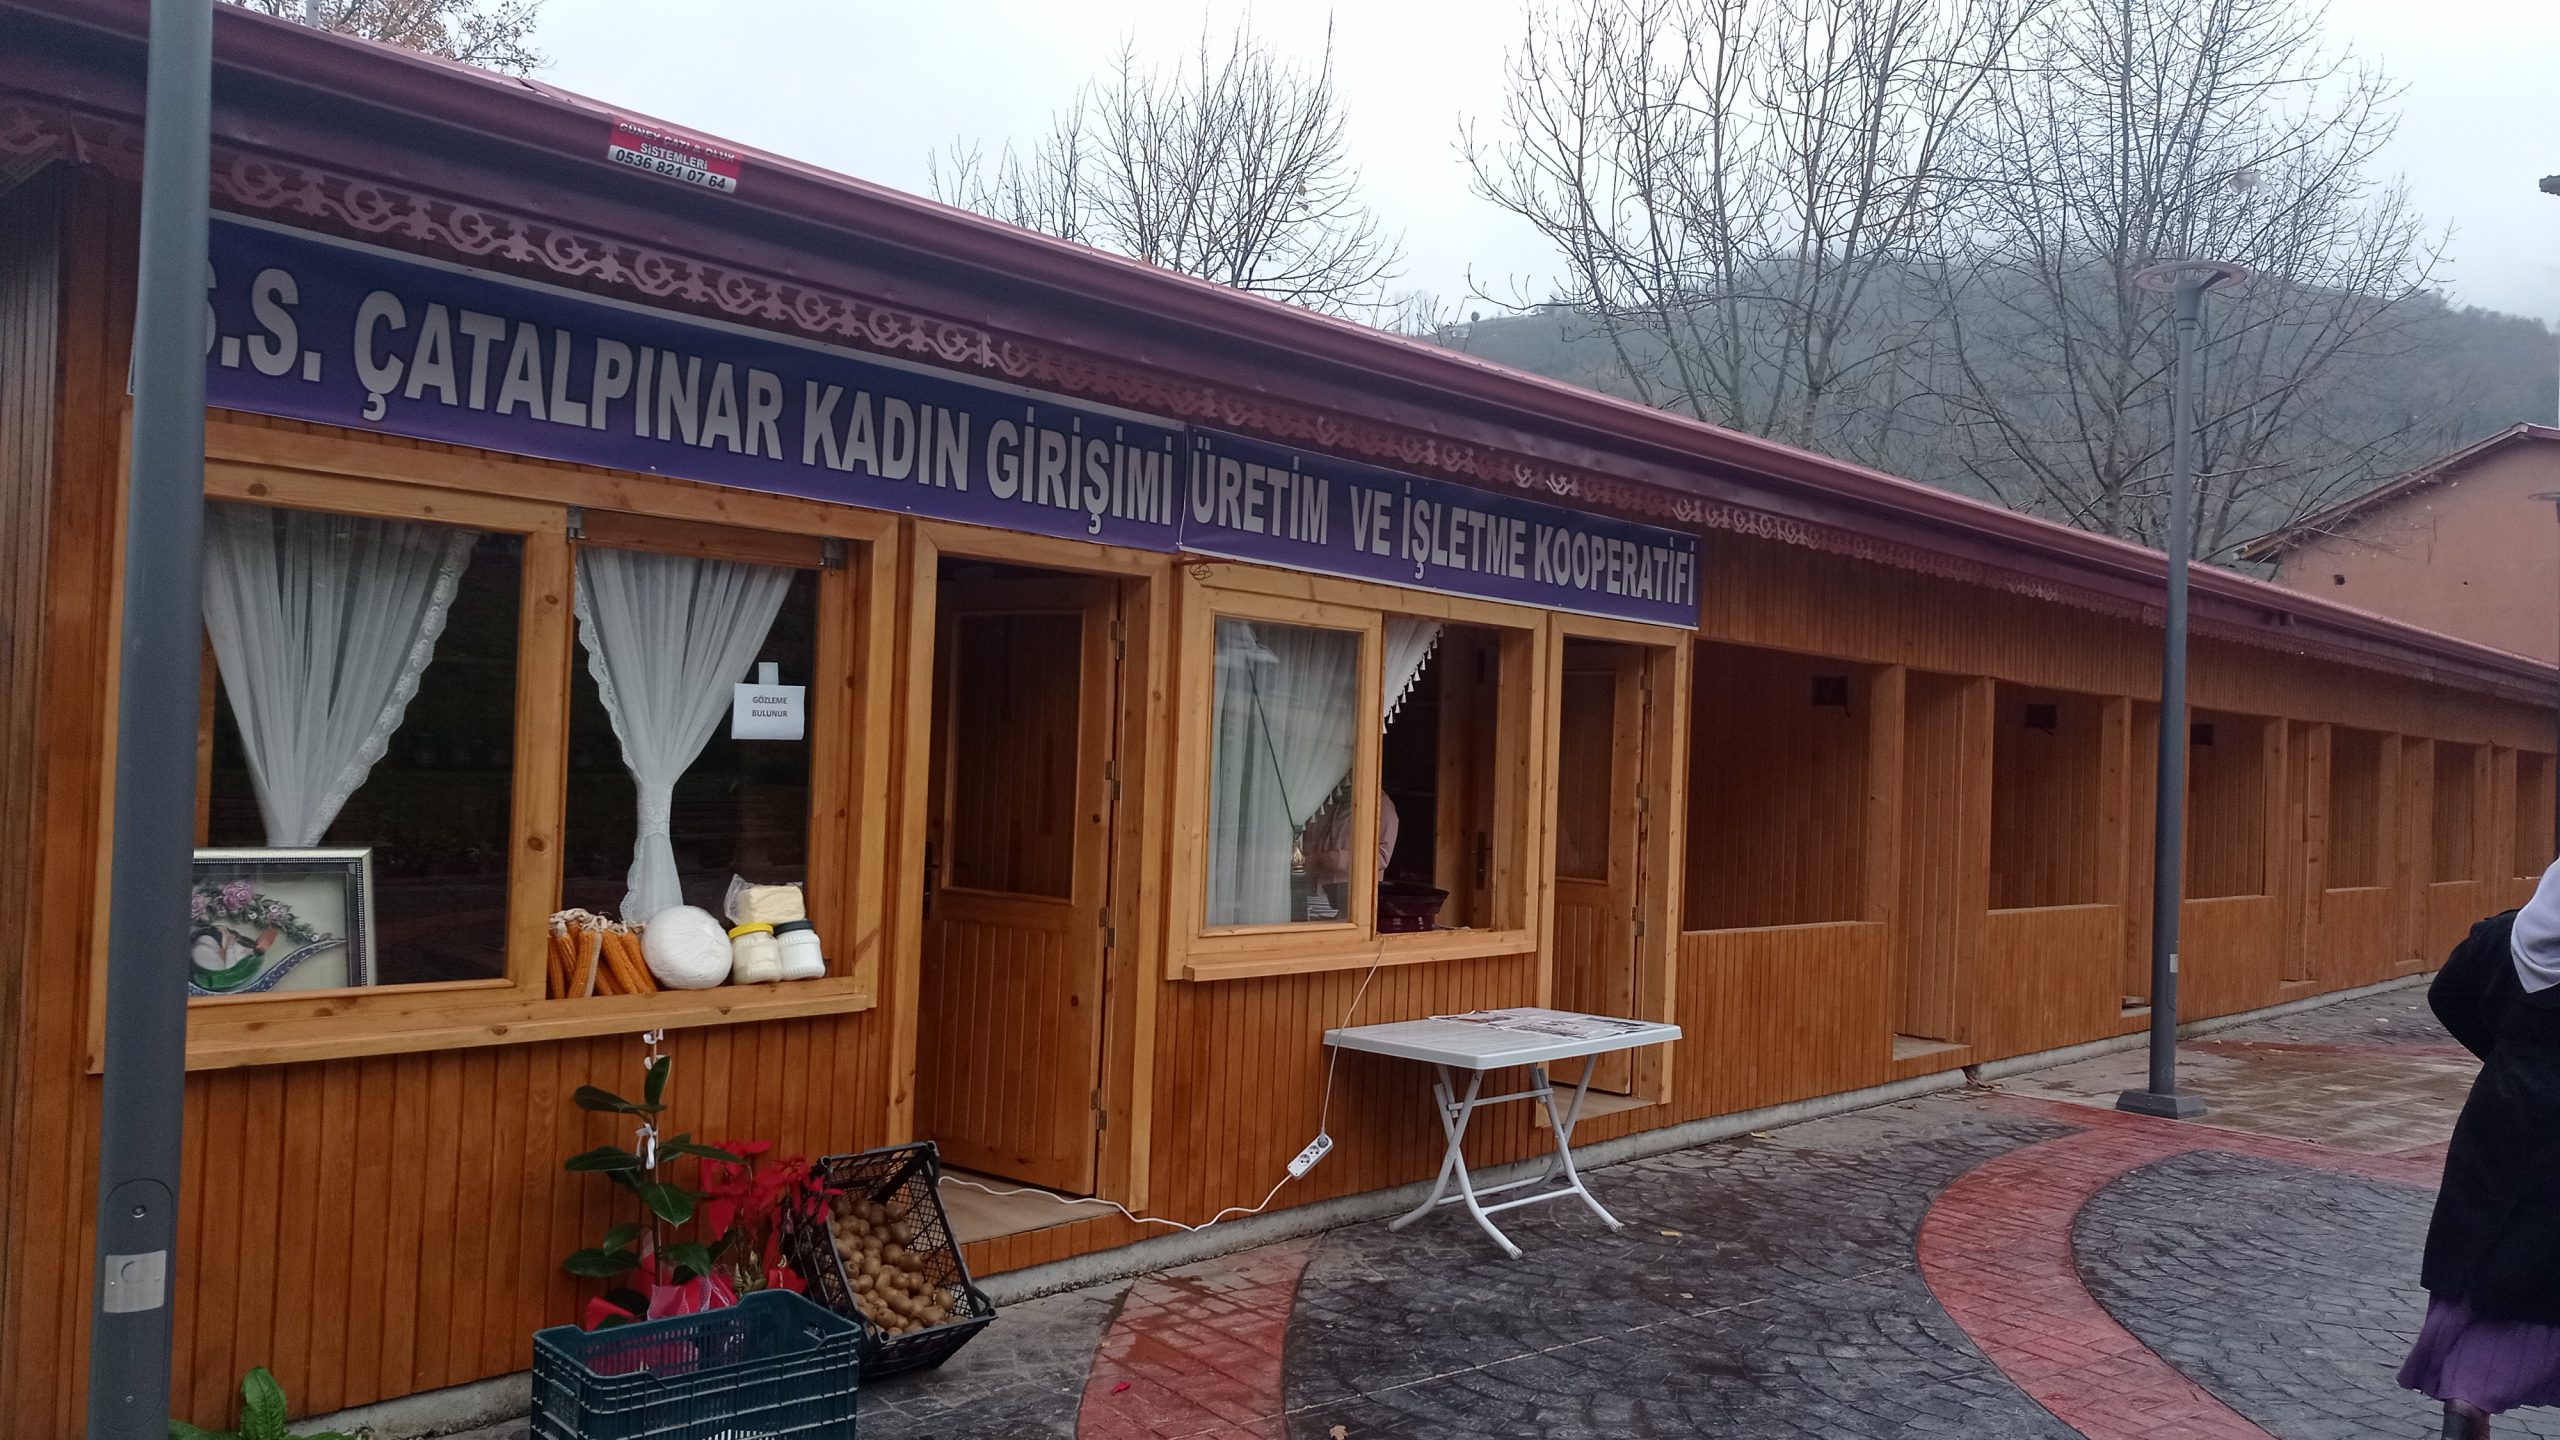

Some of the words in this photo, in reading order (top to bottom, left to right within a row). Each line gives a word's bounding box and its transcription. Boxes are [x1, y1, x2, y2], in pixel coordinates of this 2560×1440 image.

[615, 149, 653, 169] 0536
[655, 160, 682, 178] 821
[687, 169, 706, 183] 07
[708, 175, 726, 189] 64
[353, 290, 783, 461] ÇATALPINAR
[802, 380, 970, 491] KADIN
[987, 406, 1173, 535] GİRİŞİMİ
[1191, 436, 1329, 545] ÜRETİM
[1350, 485, 1392, 556] VE
[1401, 480, 1525, 580] İŞLETME
[1534, 524, 1695, 606] KOOPERATİFİ
[752, 696, 788, 704] GÖZLEME
